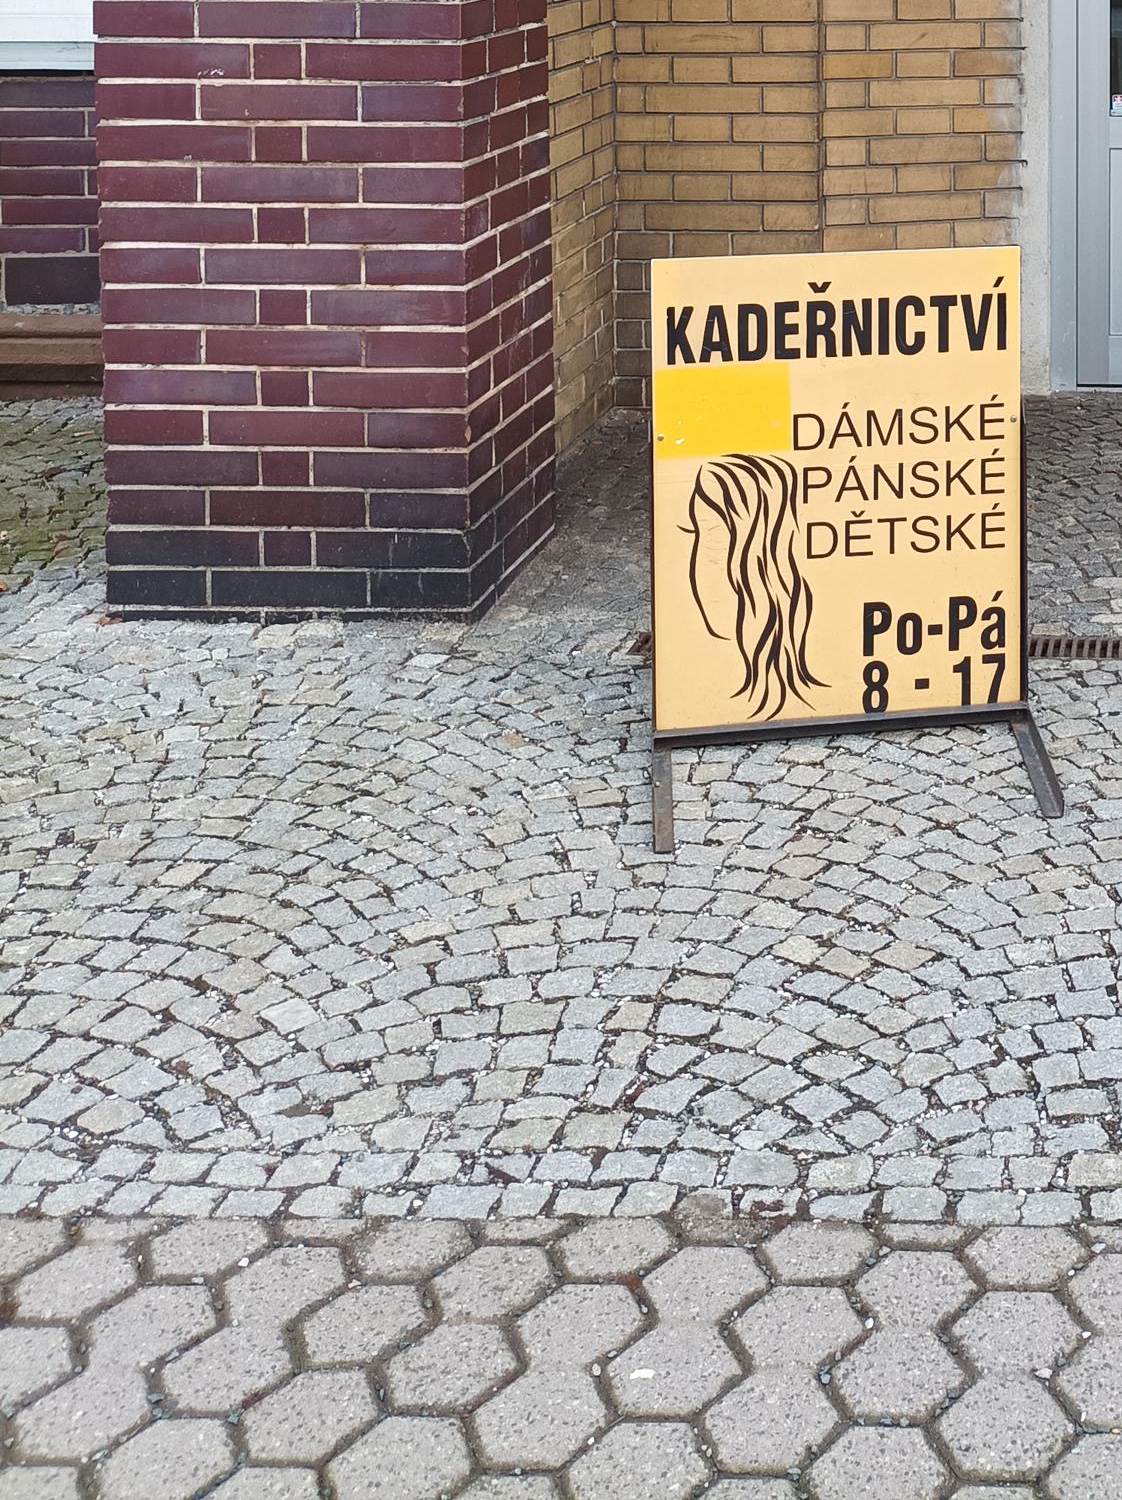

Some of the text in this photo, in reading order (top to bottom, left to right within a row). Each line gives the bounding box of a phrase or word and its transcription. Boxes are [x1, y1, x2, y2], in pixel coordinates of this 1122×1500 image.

[667, 276, 1008, 364] KADEŘNICTVÍ
[792, 395, 1004, 451] DÁMSKÉ
[803, 449, 1004, 503] PÁNSKÉ
[806, 503, 1005, 559] DĚTSKÉ
[863, 591, 1006, 656] Po-Pá
[863, 661, 888, 714] 8
[952, 654, 1005, 706] 17
